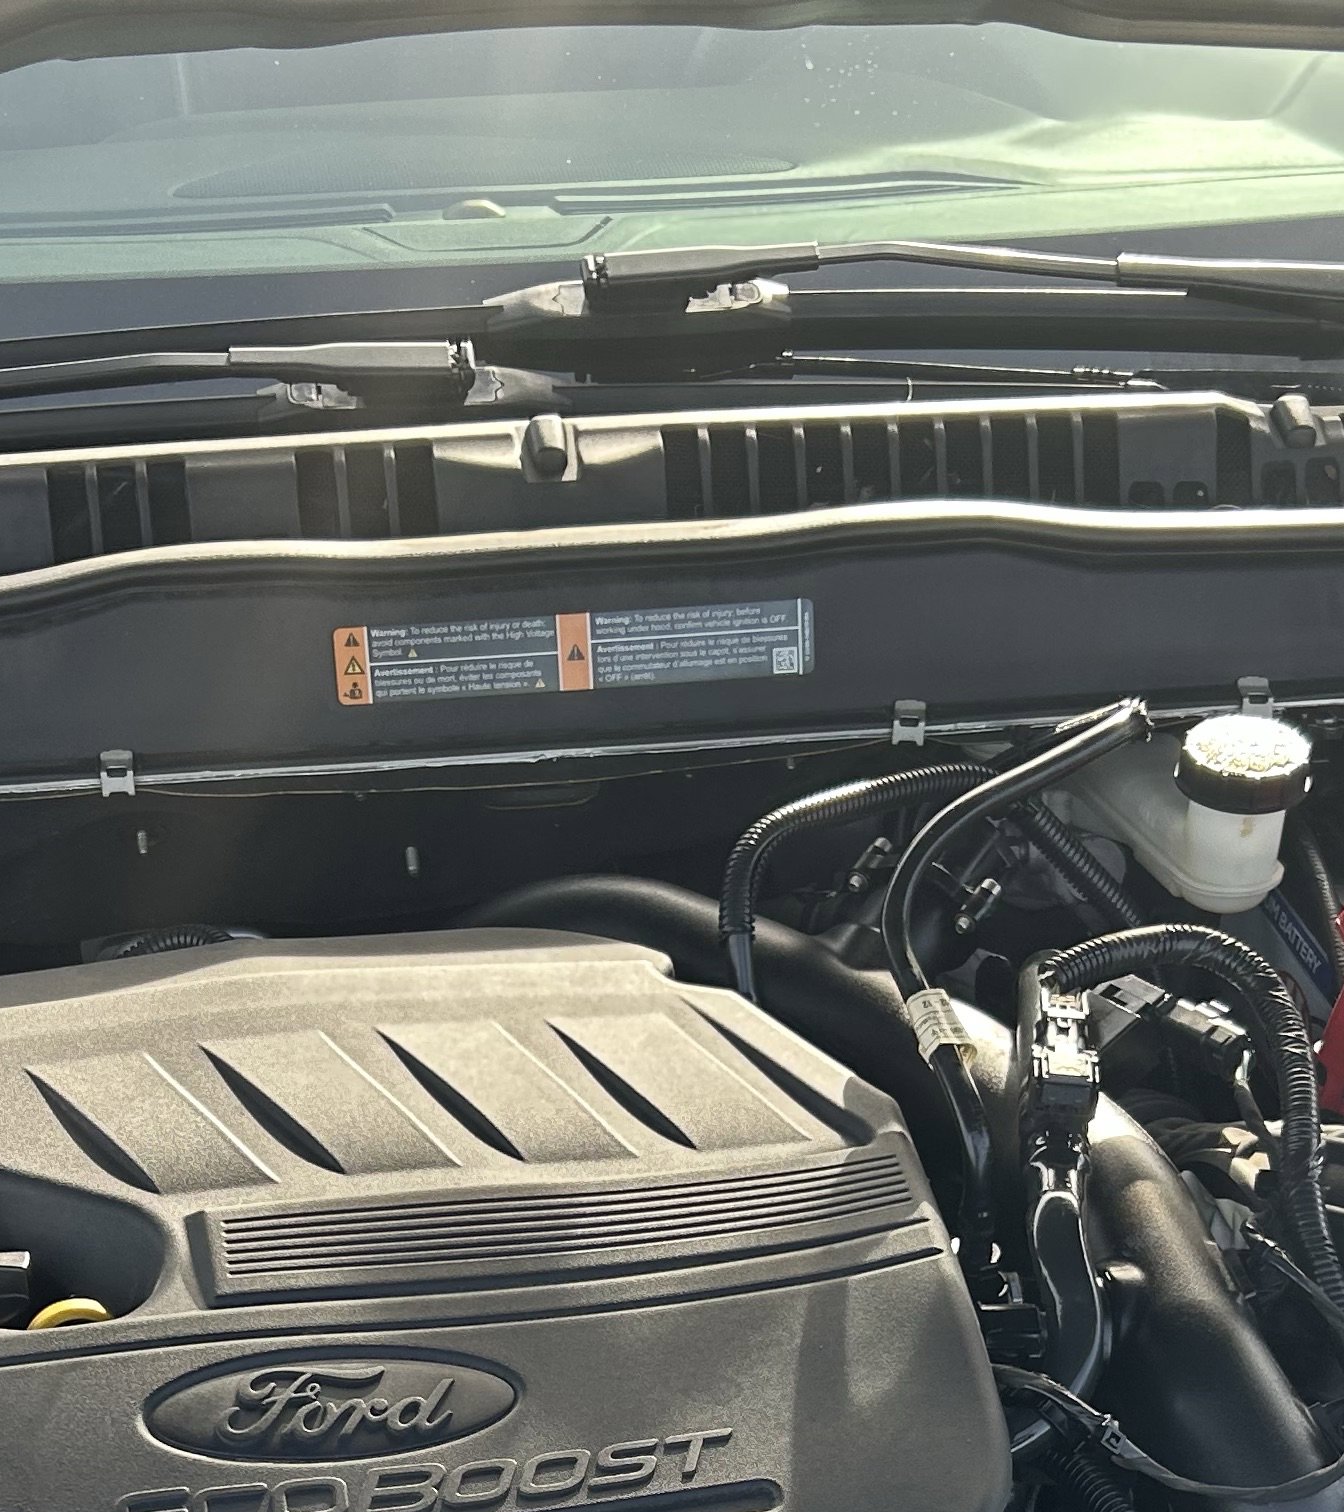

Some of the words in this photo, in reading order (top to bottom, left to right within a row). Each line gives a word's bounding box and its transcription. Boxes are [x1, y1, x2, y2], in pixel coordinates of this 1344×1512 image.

[633, 613, 643, 623] To
[644, 612, 672, 622] reduce
[672, 611, 685, 620] the
[686, 610, 700, 619] risk
[701, 609, 710, 618] of
[735, 606, 760, 616] before
[409, 626, 420, 635] To
[420, 625, 449, 635] reduce
[449, 624, 463, 633] the
[463, 622, 478, 632] risk
[478, 621, 488, 631] of
[488, 621, 510, 632] injury
[595, 625, 626, 636] working
[627, 623, 649, 633] under
[673, 620, 703, 629] confirm
[703, 618, 730, 627] vehicle
[731, 616, 760, 627] ignition
[760, 616, 768, 624] is
[370, 638, 393, 647] avoid
[393, 635, 442, 647] components
[442, 633, 473, 643] marked
[473, 632, 490, 641] with
[491, 631, 504, 640] the
[505, 630, 524, 641] High
[525, 628, 555, 639] Voltage
[595, 642, 654, 653] Avertissement
[660, 640, 678, 649] Pour
[715, 637, 739, 646] risque
[751, 632, 788, 643] blessures
[596, 654, 611, 663] lors
[634, 650, 678, 660] intervention
[698, 648, 706, 656] le
[597, 665, 612, 673] que
[613, 664, 621, 672] le
[713, 657, 726, 665] est
[737, 653, 768, 664] position
[373, 665, 433, 677] Avertissement
[439, 663, 459, 673] Pour
[488, 661, 496, 670] le
[497, 661, 522, 670] risque
[522, 659, 533, 668] de
[604, 672, 622, 682] OFF
[374, 677, 412, 687] blessures
[424, 675, 435, 684] de
[481, 671, 493, 680] les
[375, 689, 388, 697] qui
[388, 687, 417, 697] portent
[417, 685, 425, 694] le
[426, 684, 460, 695] symbole
[467, 681, 492, 690] Haute
[492, 680, 522, 689] tension
[1279, 911, 1322, 974] BATTERY
[214, 1364, 457, 1444] Ford
